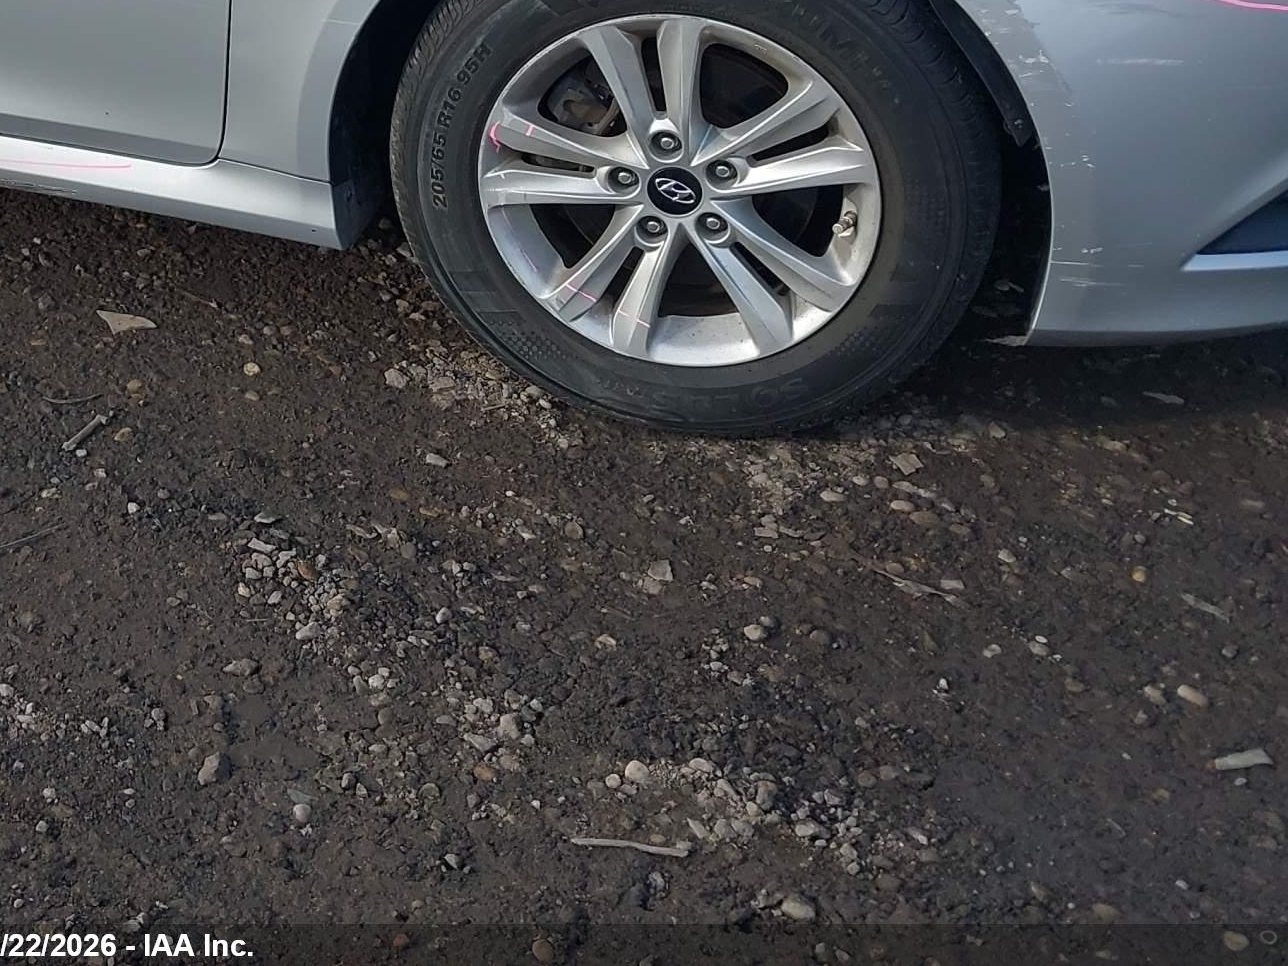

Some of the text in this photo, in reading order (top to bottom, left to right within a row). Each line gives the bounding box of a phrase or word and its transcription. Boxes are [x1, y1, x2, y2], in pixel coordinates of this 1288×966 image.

[430, 42, 492, 210] 205/65 R16 95H
